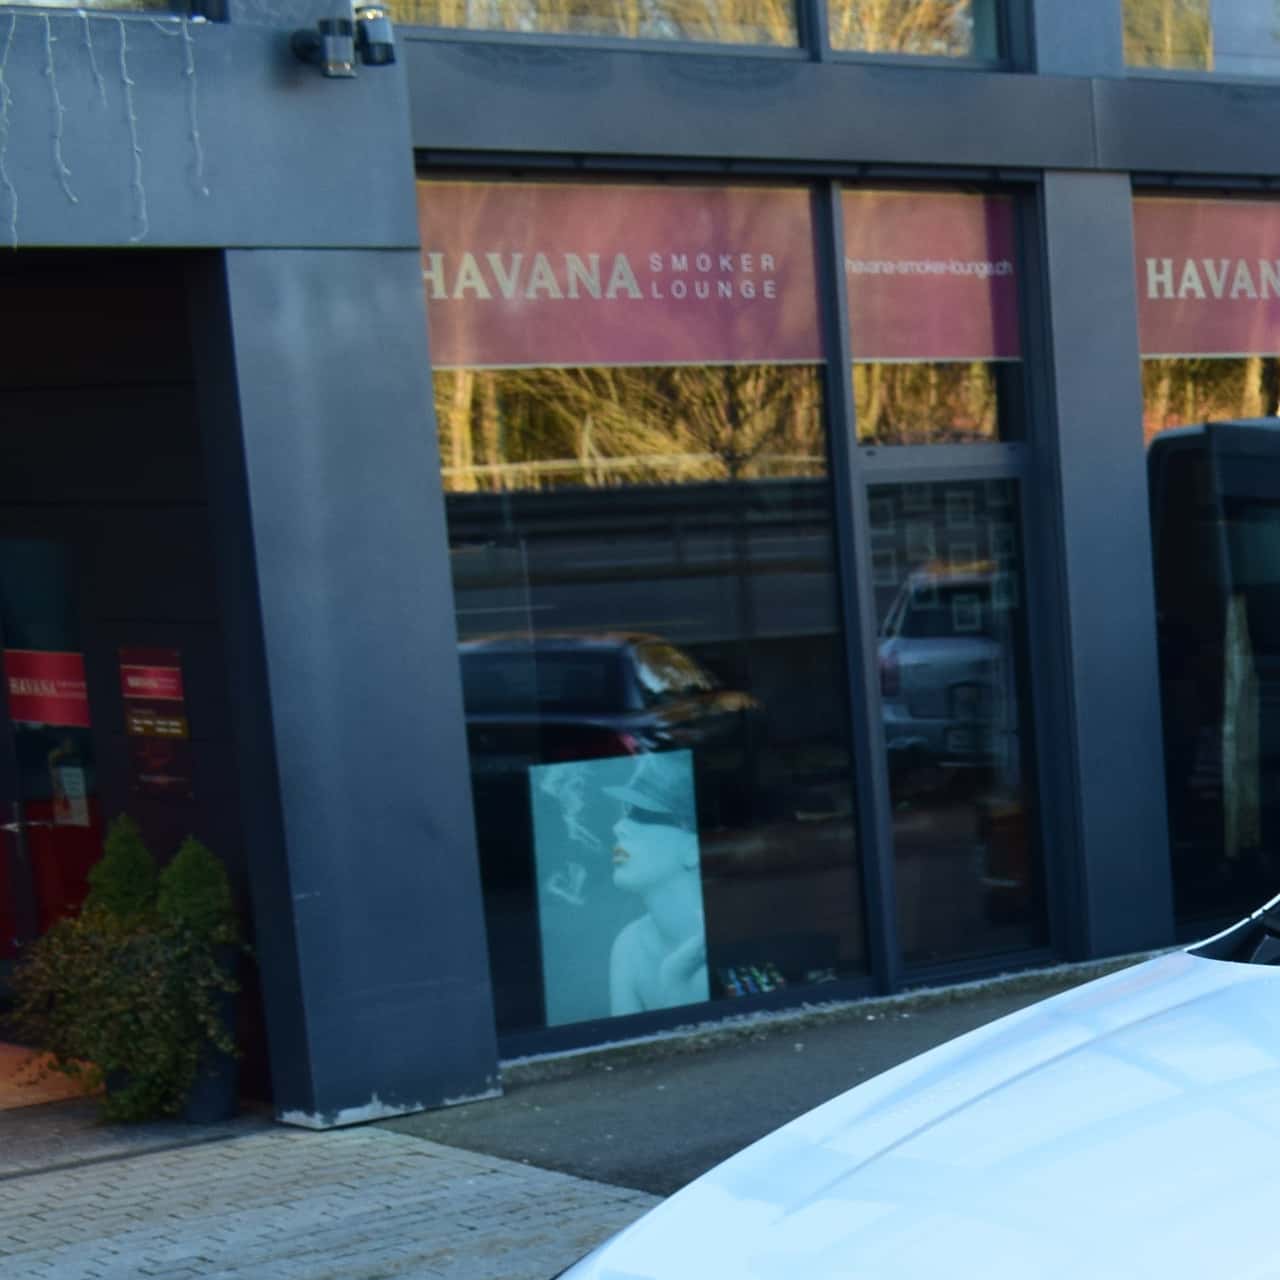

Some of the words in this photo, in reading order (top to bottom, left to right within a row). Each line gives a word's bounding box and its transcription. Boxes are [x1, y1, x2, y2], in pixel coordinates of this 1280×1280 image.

[649, 254, 775, 272] SMOKER
[423, 252, 643, 299] HAVANA
[651, 281, 777, 299] LOUNGE
